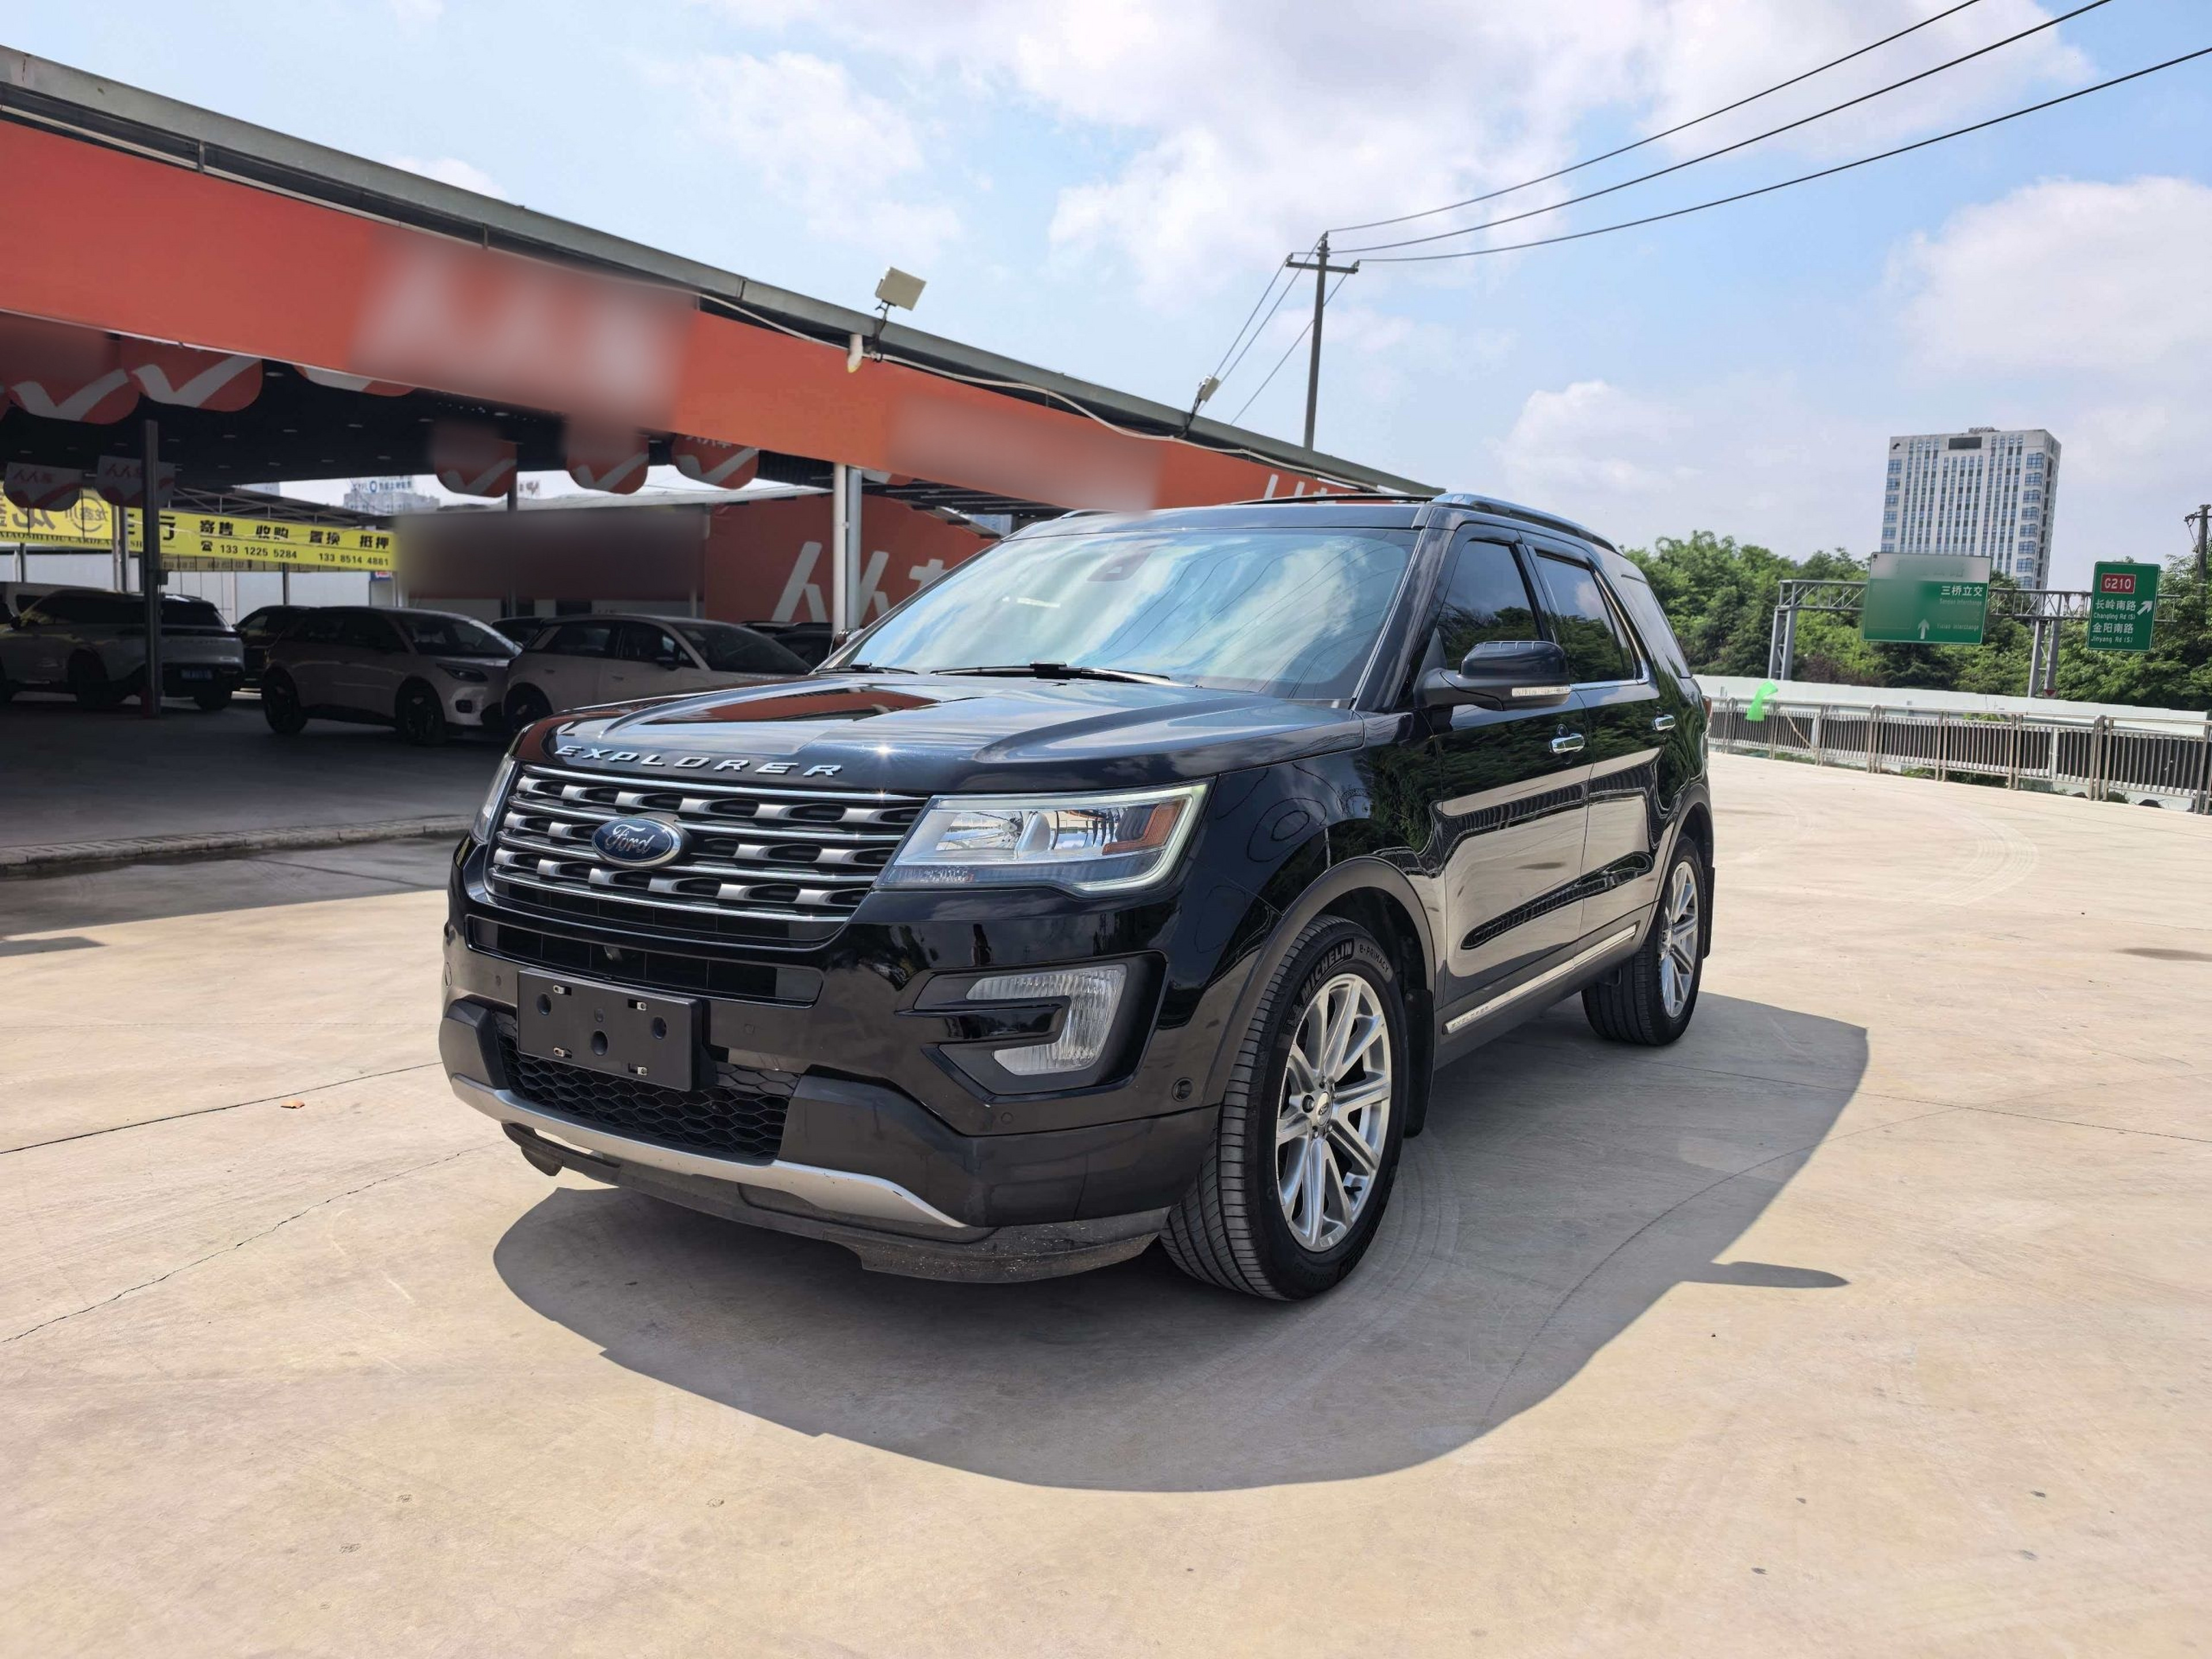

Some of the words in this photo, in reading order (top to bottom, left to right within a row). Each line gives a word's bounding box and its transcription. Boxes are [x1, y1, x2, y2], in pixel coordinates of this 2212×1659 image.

[256, 525, 289, 540] 收购
[359, 535, 389, 549] 抵押
[220, 544, 238, 554] 133
[244, 547, 268, 556] 1225
[274, 549, 297, 559] 5284
[319, 553, 335, 562] 133
[340, 555, 362, 564] 8514
[2104, 578, 2131, 589] G210
[1941, 585, 1983, 596] 三桥立交
[2095, 599, 2137, 611] 长岭南路
[2093, 612, 2118, 620] Changling
[2092, 622, 2134, 634] 金阳南路
[2091, 635, 2112, 644] Jinyang
[554, 745, 844, 778] EXPLORER
[604, 824, 656, 855] Ford
[1301, 941, 1353, 1003] MICHELIN
